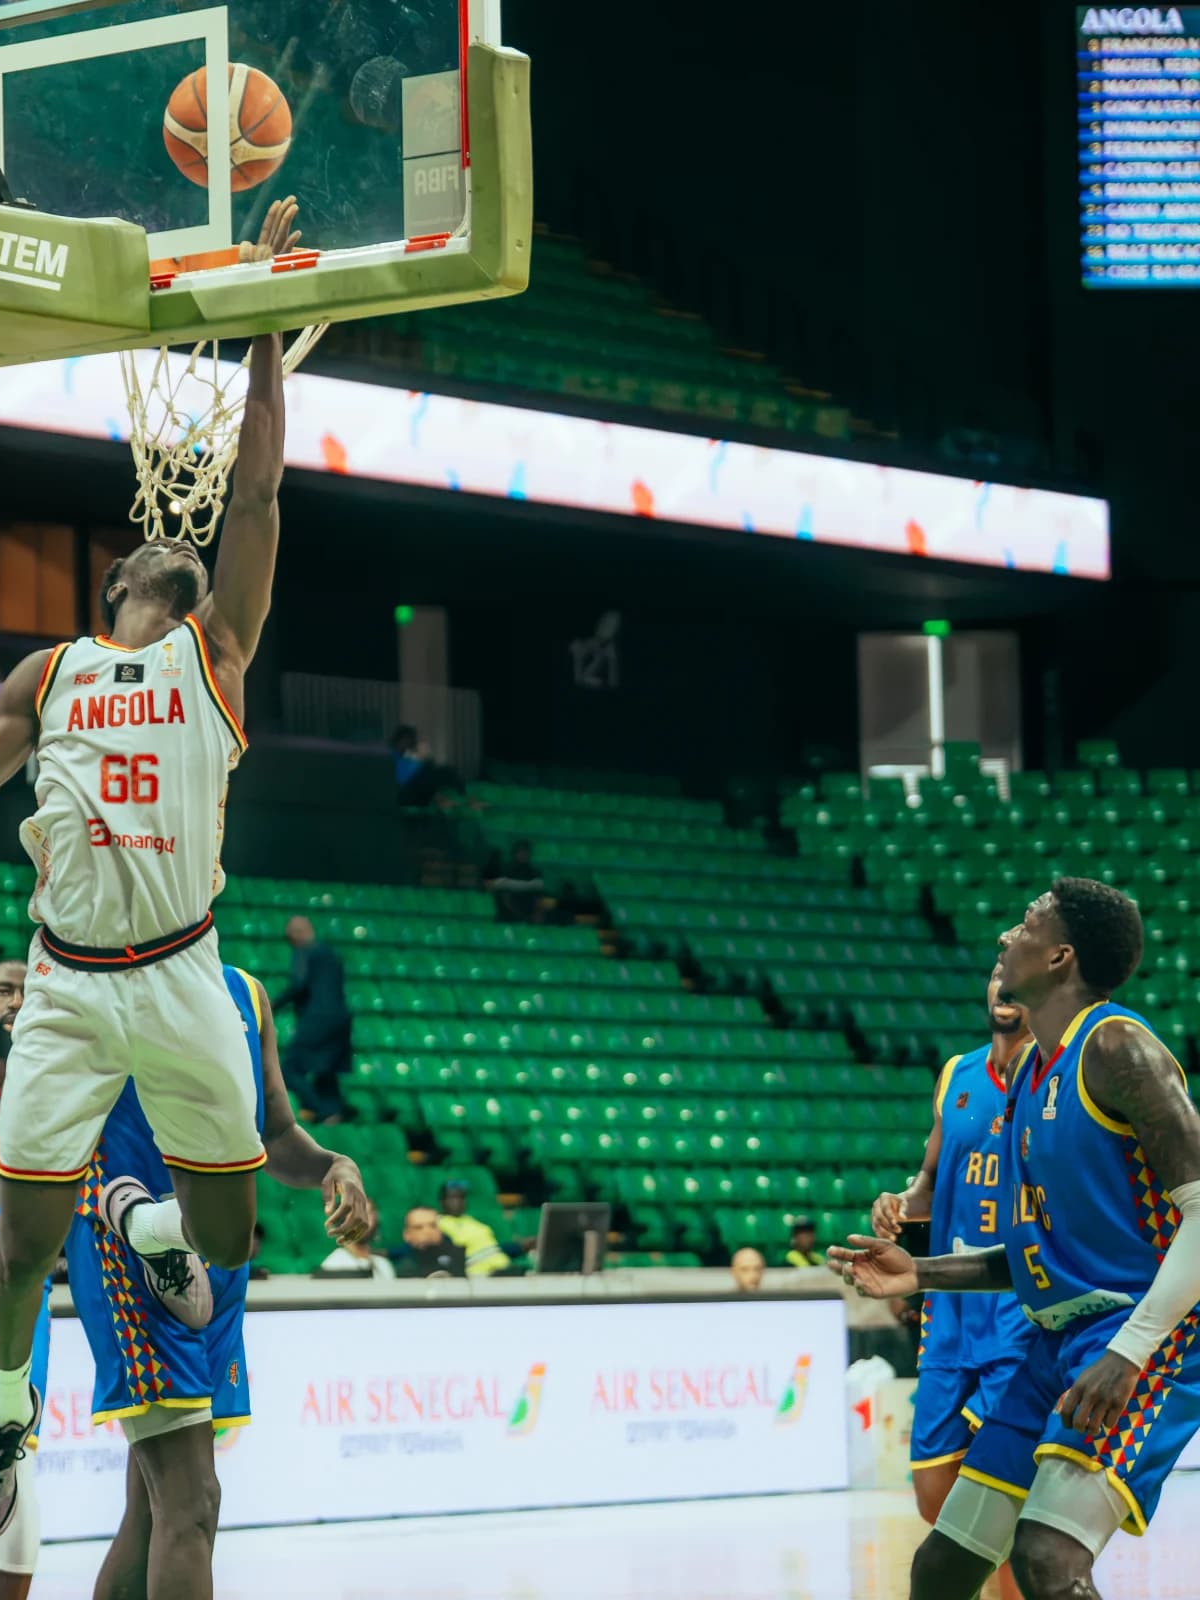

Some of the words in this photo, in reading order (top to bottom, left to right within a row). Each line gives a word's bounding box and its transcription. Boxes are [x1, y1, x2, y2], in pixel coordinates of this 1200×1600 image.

[1081, 8, 1183, 34] ANGOLA
[66, 687, 186, 732] ANGOLA
[100, 753, 159, 804] 66
[979, 1199, 997, 1233] 3
[1023, 1244, 1051, 1290] 5
[303, 1381, 355, 1425] AIR
[367, 1376, 507, 1422] SENEGAL
[591, 1368, 640, 1415] AIR
[649, 1362, 774, 1411] SENEGAL
